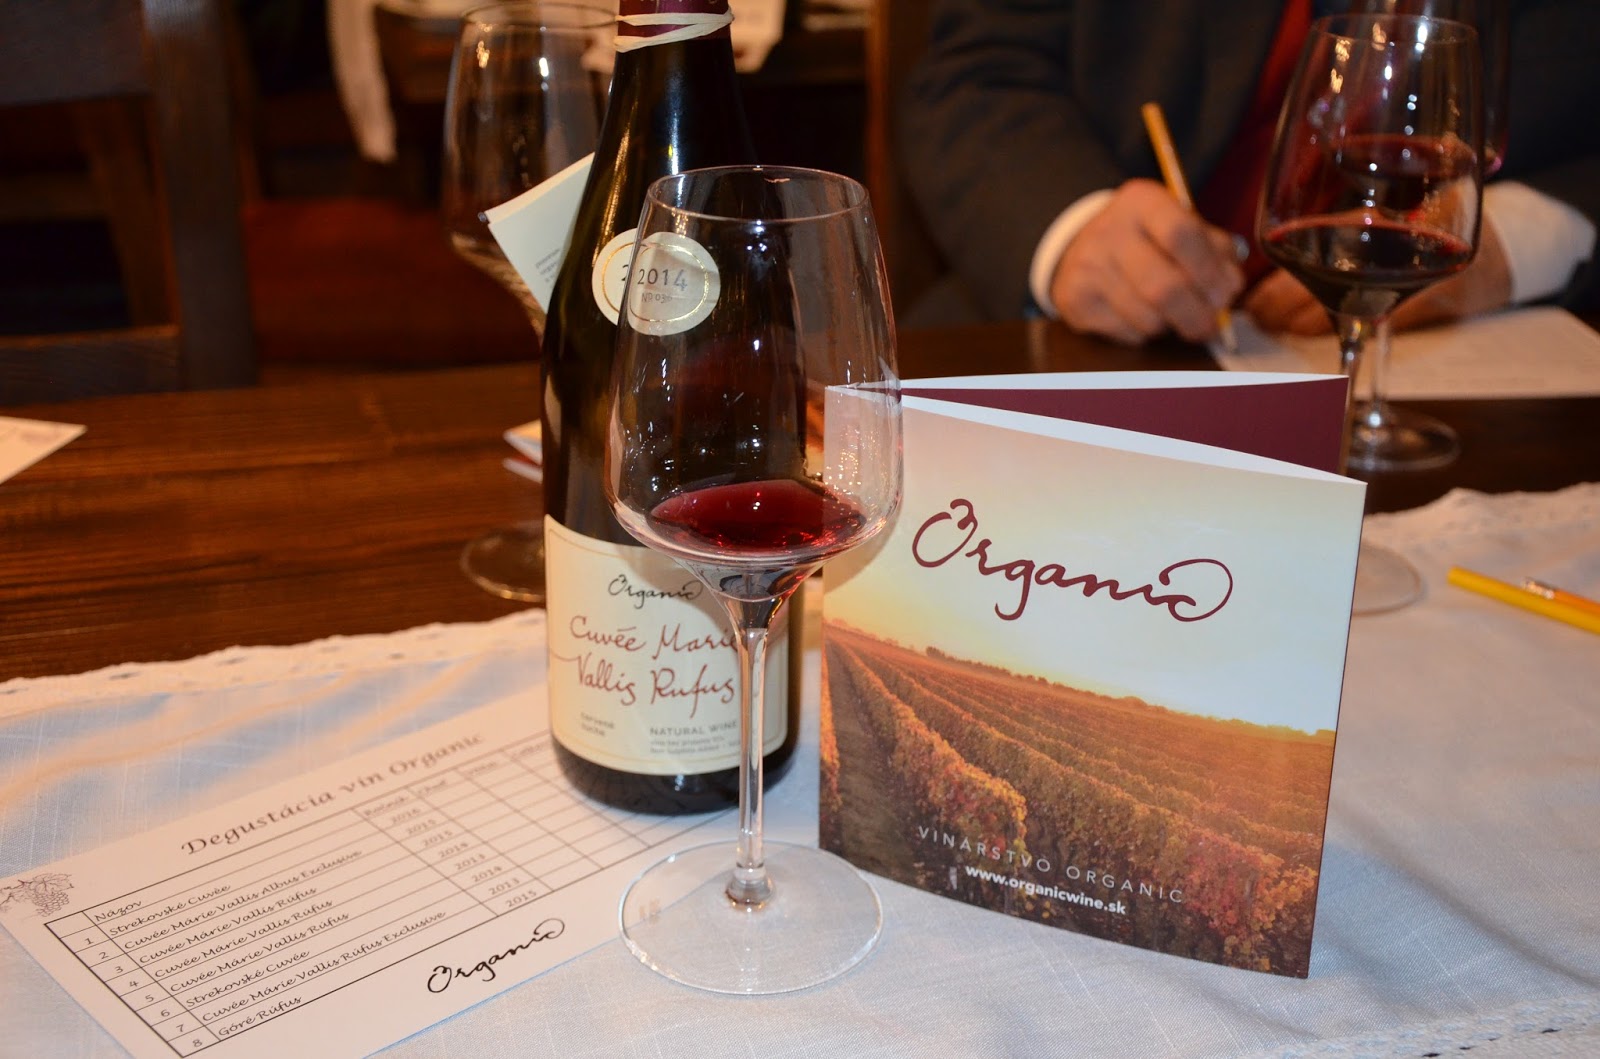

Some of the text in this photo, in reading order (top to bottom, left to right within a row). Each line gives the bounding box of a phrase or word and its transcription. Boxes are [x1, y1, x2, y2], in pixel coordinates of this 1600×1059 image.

[638, 268, 688, 291] 2014
[608, 574, 703, 609] Organic
[911, 498, 1233, 622] Organic
[551, 651, 735, 718] Vallis Rufus
[389, 734, 484, 777] Organic
[918, 825, 1183, 903] VINARSTVO ORGANIC
[964, 865, 1127, 915] www.organicwine.sk
[84, 937, 94, 945] 1
[94, 901, 142, 922] Názov
[98, 951, 109, 960] 2
[124, 928, 171, 949] Cuvée
[216, 891, 259, 912] Vallis
[262, 875, 300, 896] Albus
[115, 966, 124, 974] 3
[139, 942, 186, 964] Cuvée
[231, 907, 275, 926] Vallis
[129, 980, 139, 988] 4
[154, 956, 201, 978] Cuvée
[247, 919, 291, 939] Vallis
[145, 994, 154, 1003] 5
[170, 970, 217, 992] Cuvée
[262, 930, 307, 952] Vallis
[160, 1009, 170, 1018] 6
[186, 969, 265, 1007] Strekovské
[265, 951, 310, 973] Cuvée
[176, 1024, 185, 1033] 7
[202, 998, 249, 1021] Cuvée
[295, 958, 340, 980] Vallis
[383, 911, 446, 942] Exclusive
[192, 1039, 203, 1048] 8
[505, 889, 537, 908] 2015
[427, 917, 565, 993] Organic
